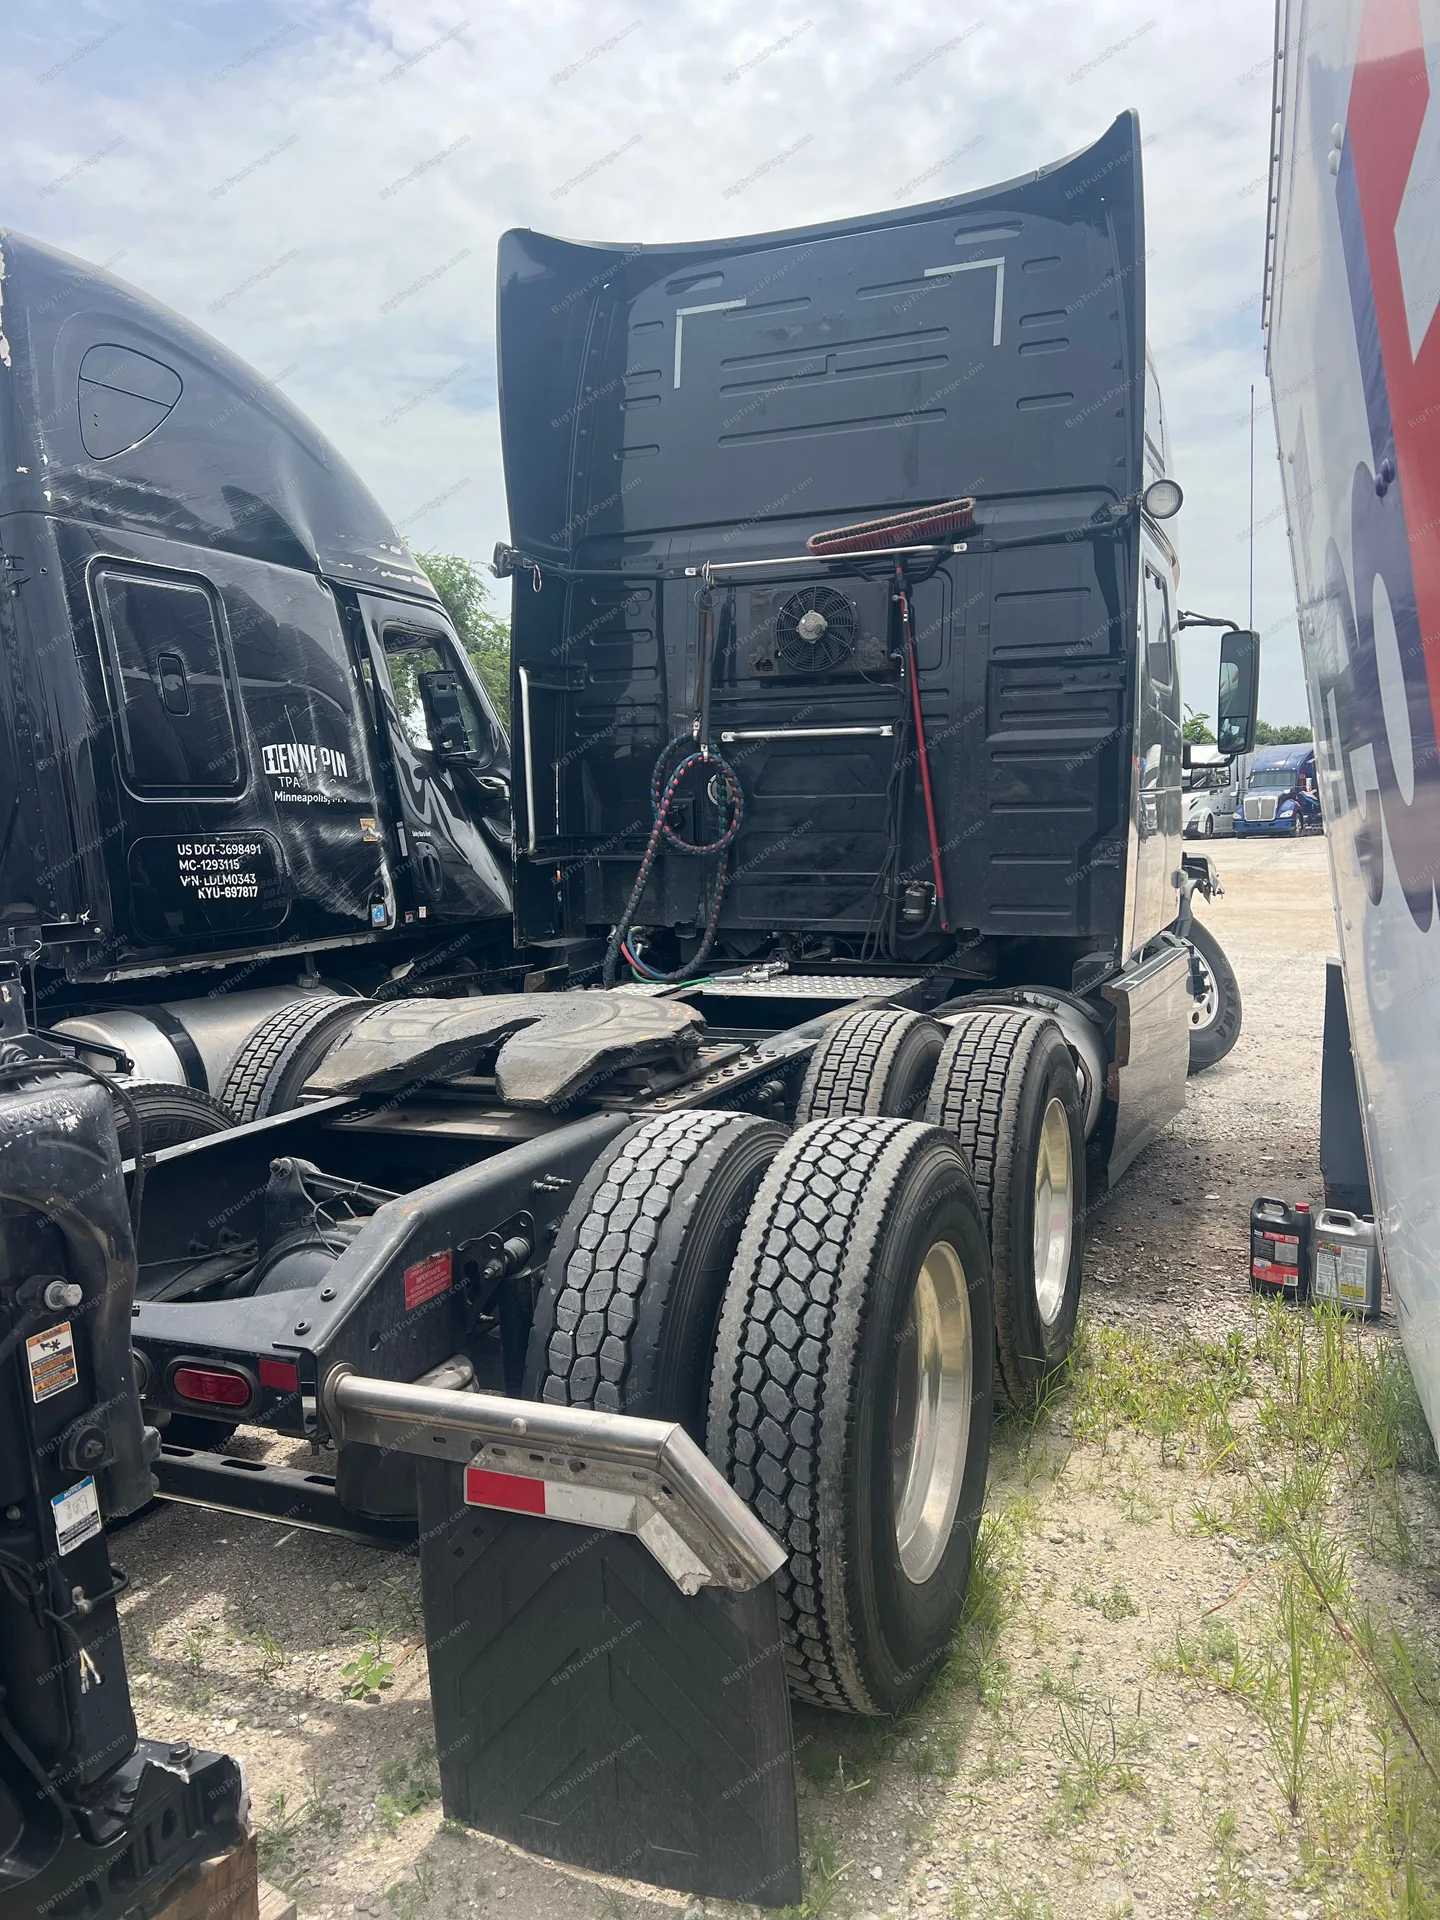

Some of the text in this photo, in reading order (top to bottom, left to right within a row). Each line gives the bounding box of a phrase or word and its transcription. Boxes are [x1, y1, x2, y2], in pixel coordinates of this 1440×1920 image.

[274, 791, 331, 805] Minneapolis,
[177, 843, 261, 855] US DOT-3698491
[179, 859, 240, 871] MC-1293115
[198, 886, 258, 899] KYU-697817
[4, 1093, 74, 1130] PACCAR
